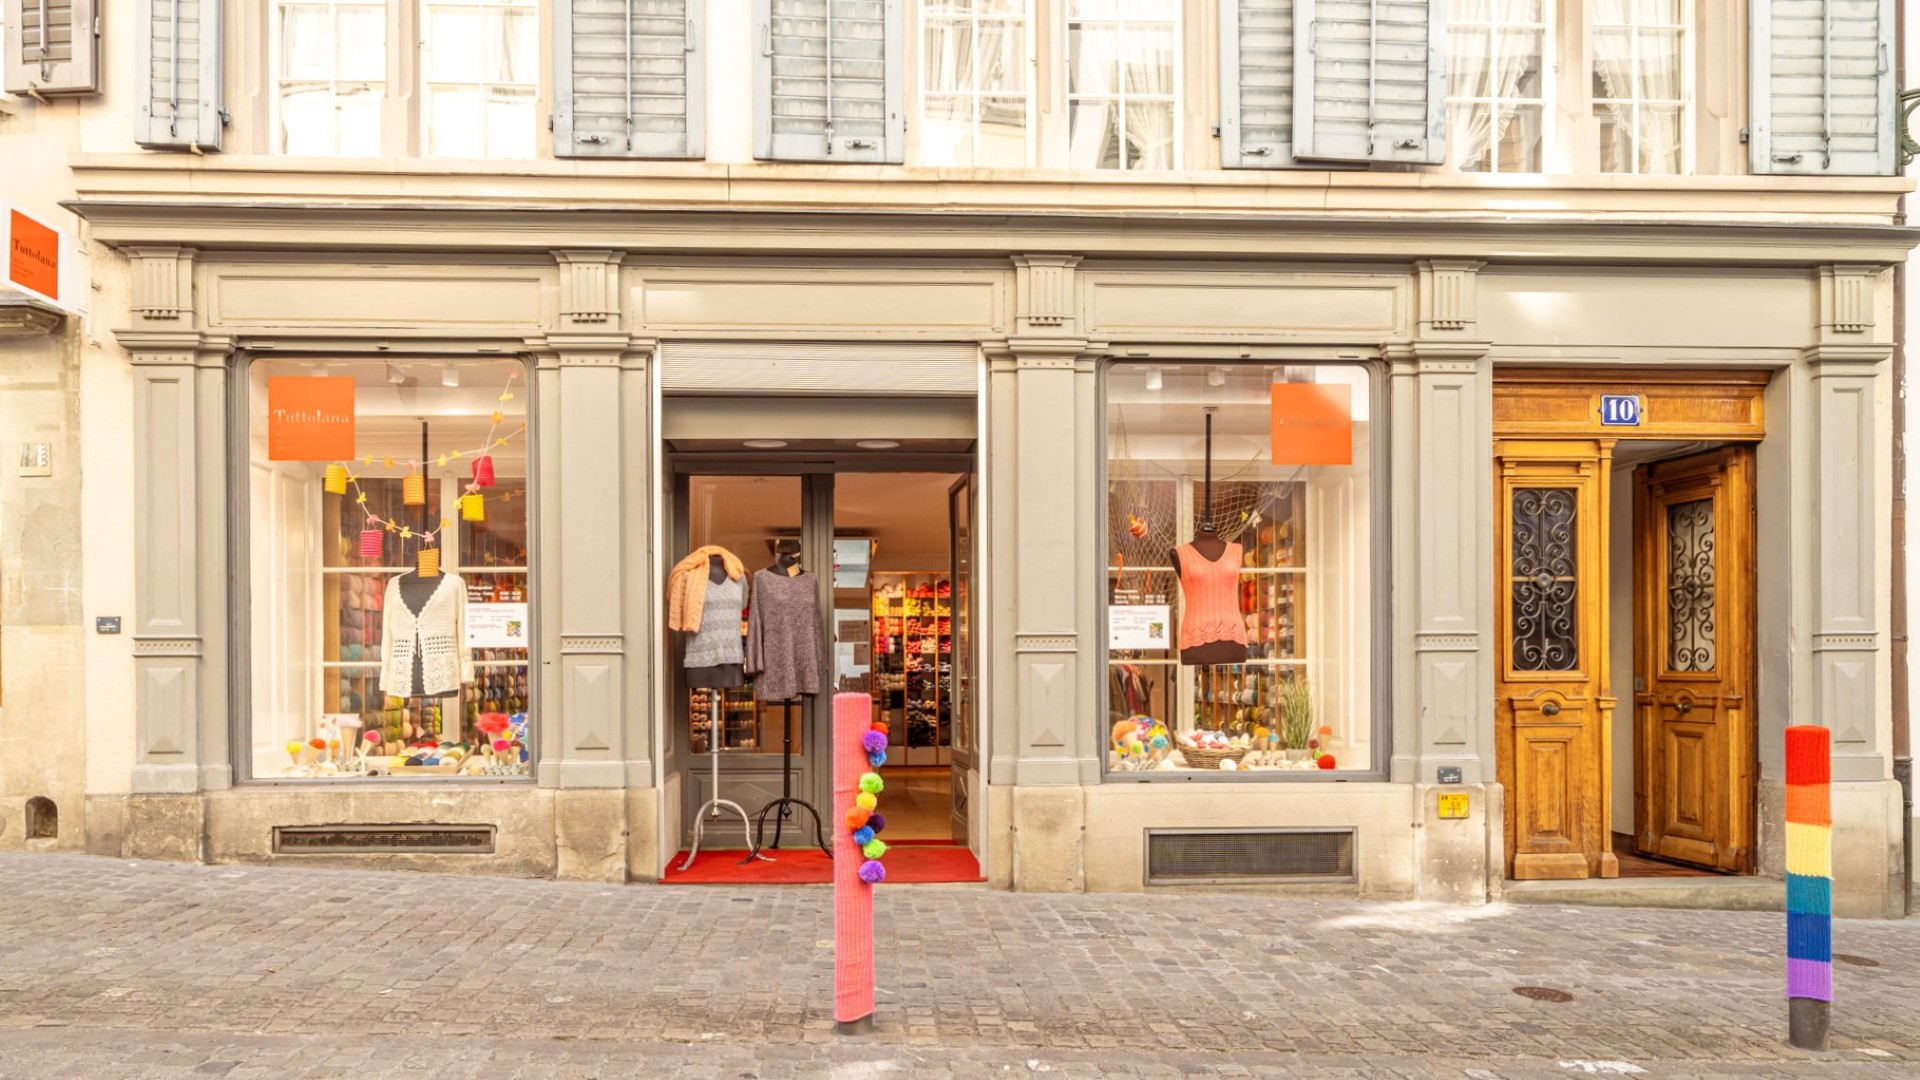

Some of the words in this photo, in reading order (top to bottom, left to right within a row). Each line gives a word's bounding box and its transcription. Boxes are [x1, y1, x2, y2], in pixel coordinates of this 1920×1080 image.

[12, 238, 56, 268] Tuttolana
[273, 408, 349, 424] Tuttolana
[1609, 399, 1634, 421] 10
